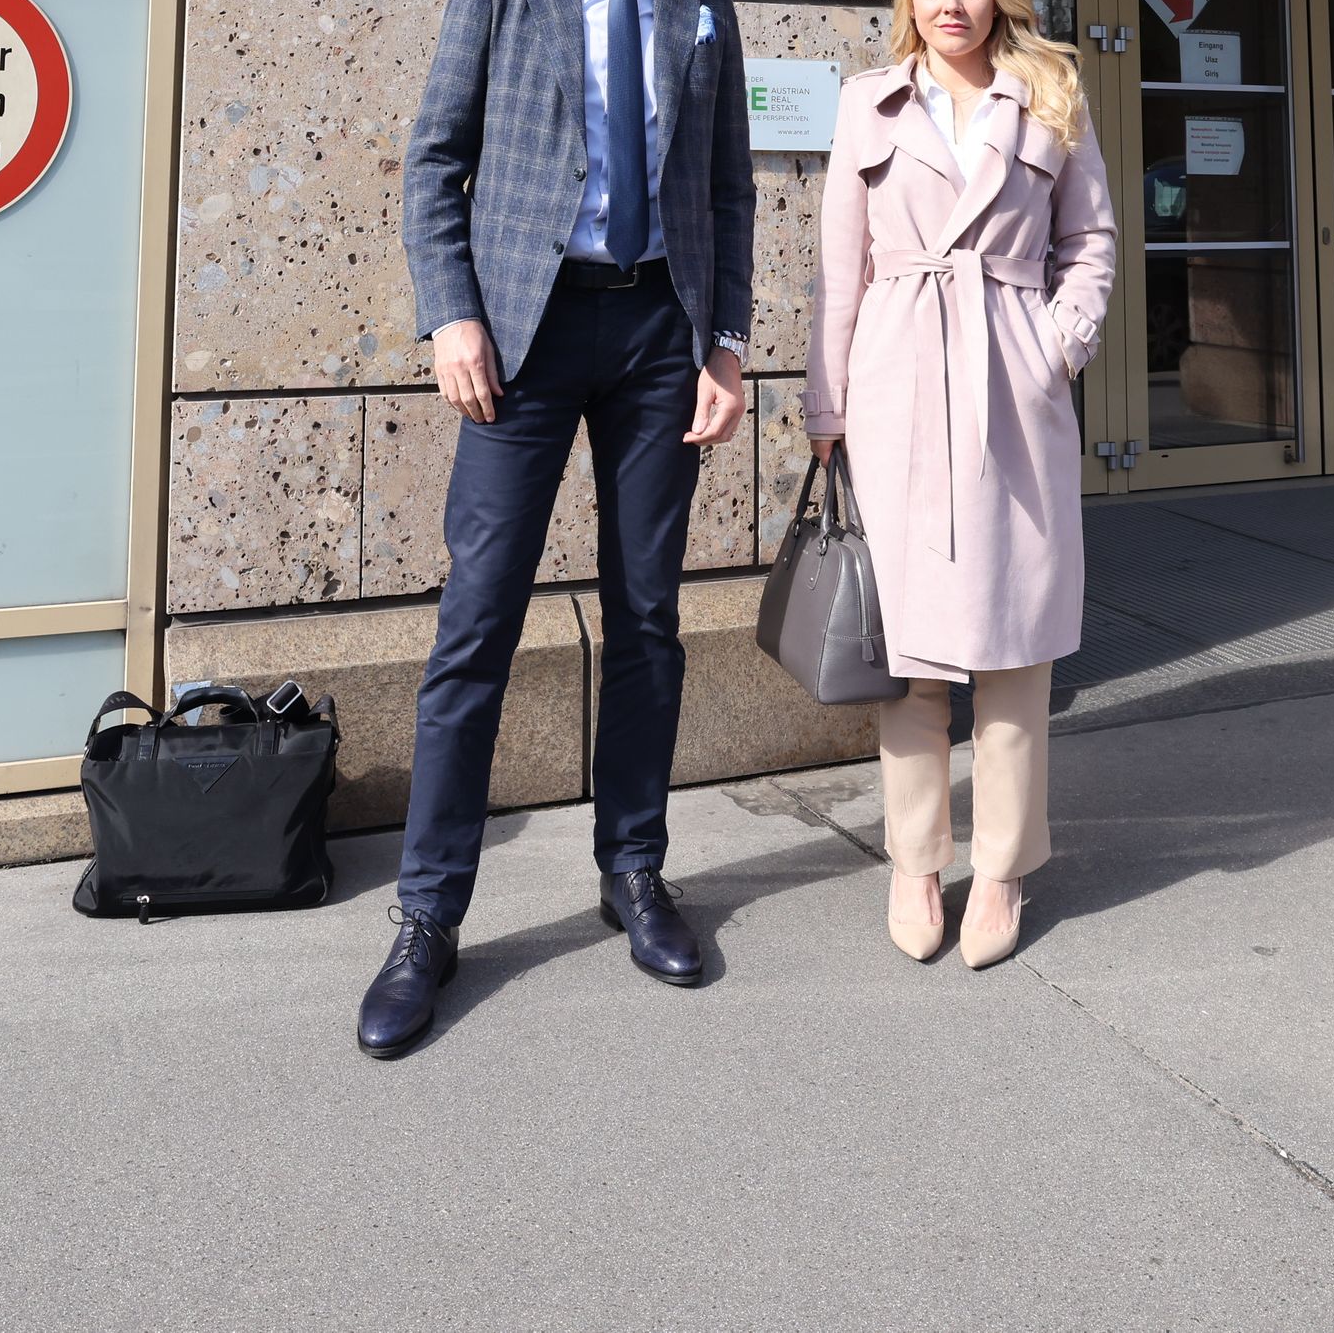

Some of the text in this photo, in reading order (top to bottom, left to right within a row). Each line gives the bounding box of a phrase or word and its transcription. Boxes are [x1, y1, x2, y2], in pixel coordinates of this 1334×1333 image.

[1198, 41, 1224, 51] Eingang
[1204, 56, 1219, 64] Ulaz
[771, 87, 810, 95] AUSTRIAN
[771, 96, 791, 104] REAL
[771, 104, 800, 112] ESTATE
